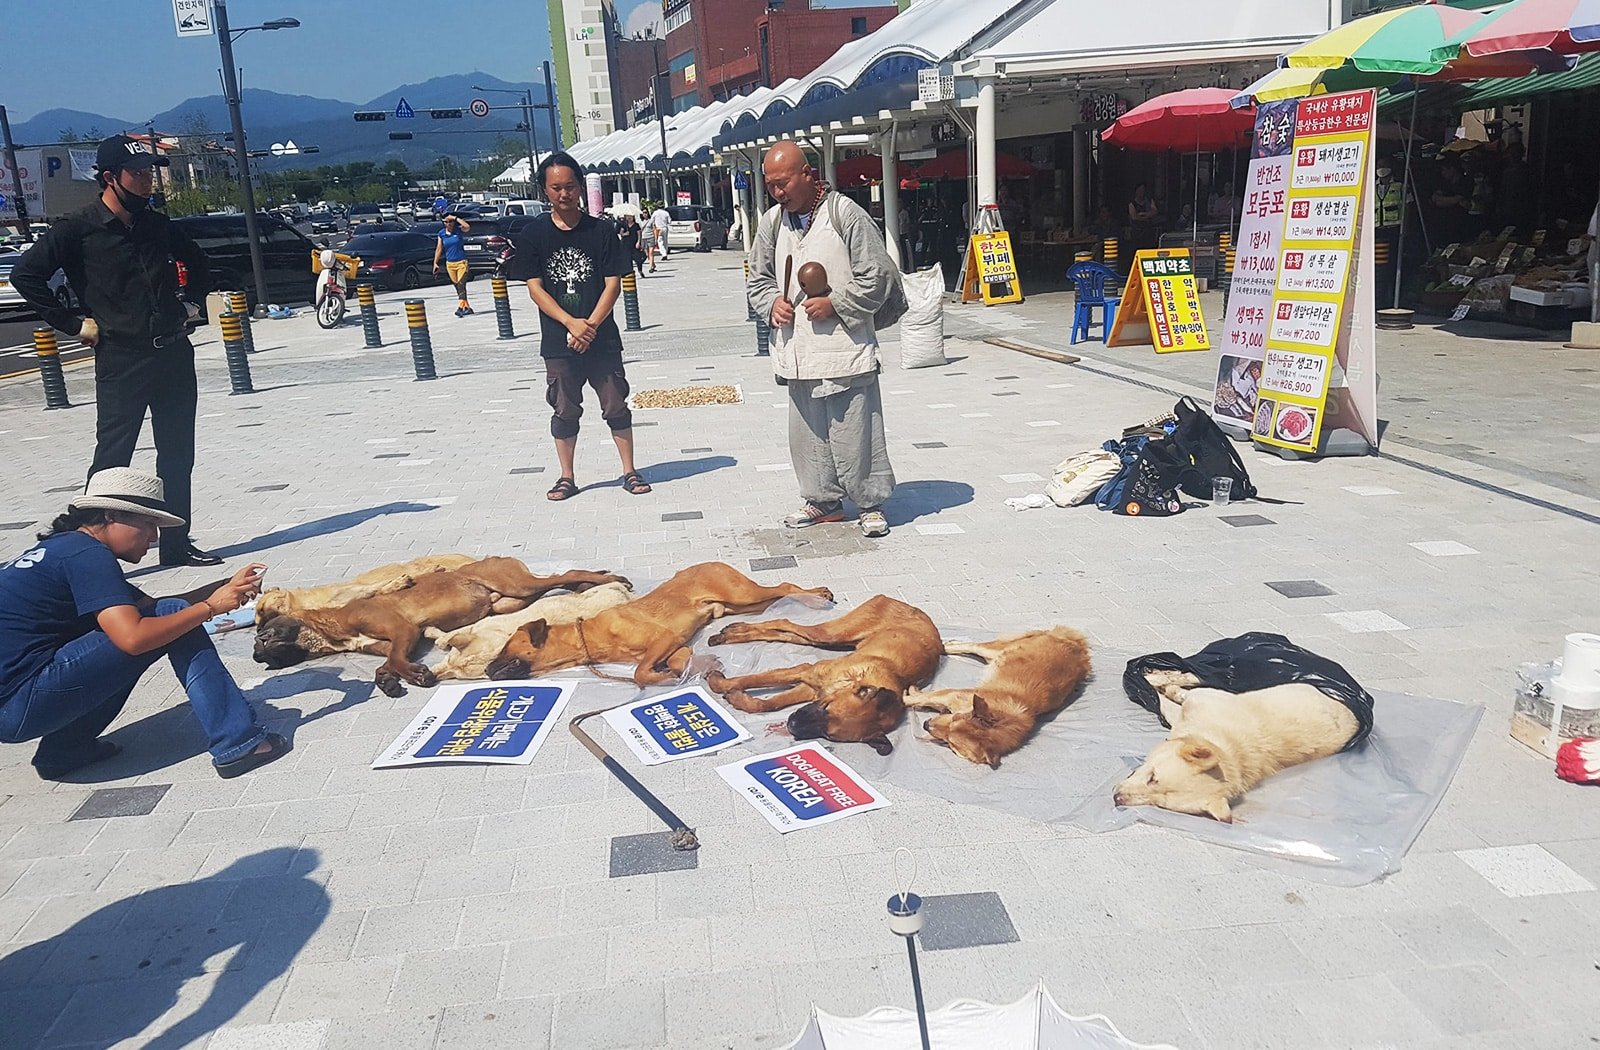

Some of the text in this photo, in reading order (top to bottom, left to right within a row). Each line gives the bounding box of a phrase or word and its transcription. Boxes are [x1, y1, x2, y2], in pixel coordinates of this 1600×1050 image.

[588, 110, 601, 119] 106
[1306, 96, 1363, 115] 국내산 유황돼지
[1345, 112, 1369, 127] 전문점
[1299, 145, 1360, 164] 유황 돼지생고기
[47, 157, 61, 177] P
[1257, 164, 1282, 186] 반건조
[1324, 171, 1355, 183] ₩10,000
[1246, 189, 1285, 218] 모듬포
[1293, 201, 1350, 216] 유황 생삼겹살
[1249, 230, 1271, 249] 1접시
[1316, 225, 1347, 237] ₩14,900
[979, 239, 1008, 254] 한식
[982, 251, 1010, 265] 뷔페
[1142, 258, 1191, 275] 백제약초
[1240, 256, 1276, 275] ₩13,000
[1287, 254, 1302, 268] 유황
[1305, 278, 1335, 290] ₩13,500
[1236, 305, 1264, 326] 생맥주
[1292, 305, 1333, 322] 생앞다리살
[1295, 356, 1323, 372] 생고기
[435, 689, 509, 755] 식품위생법 위반
[478, 695, 534, 749] 개고기 판매는
[644, 704, 681, 731] 명백한
[665, 727, 700, 751] 불법!
[677, 702, 720, 738] 개 도살은
[766, 767, 824, 808] KOREA
[786, 754, 855, 807] DOG MEAT FREE
